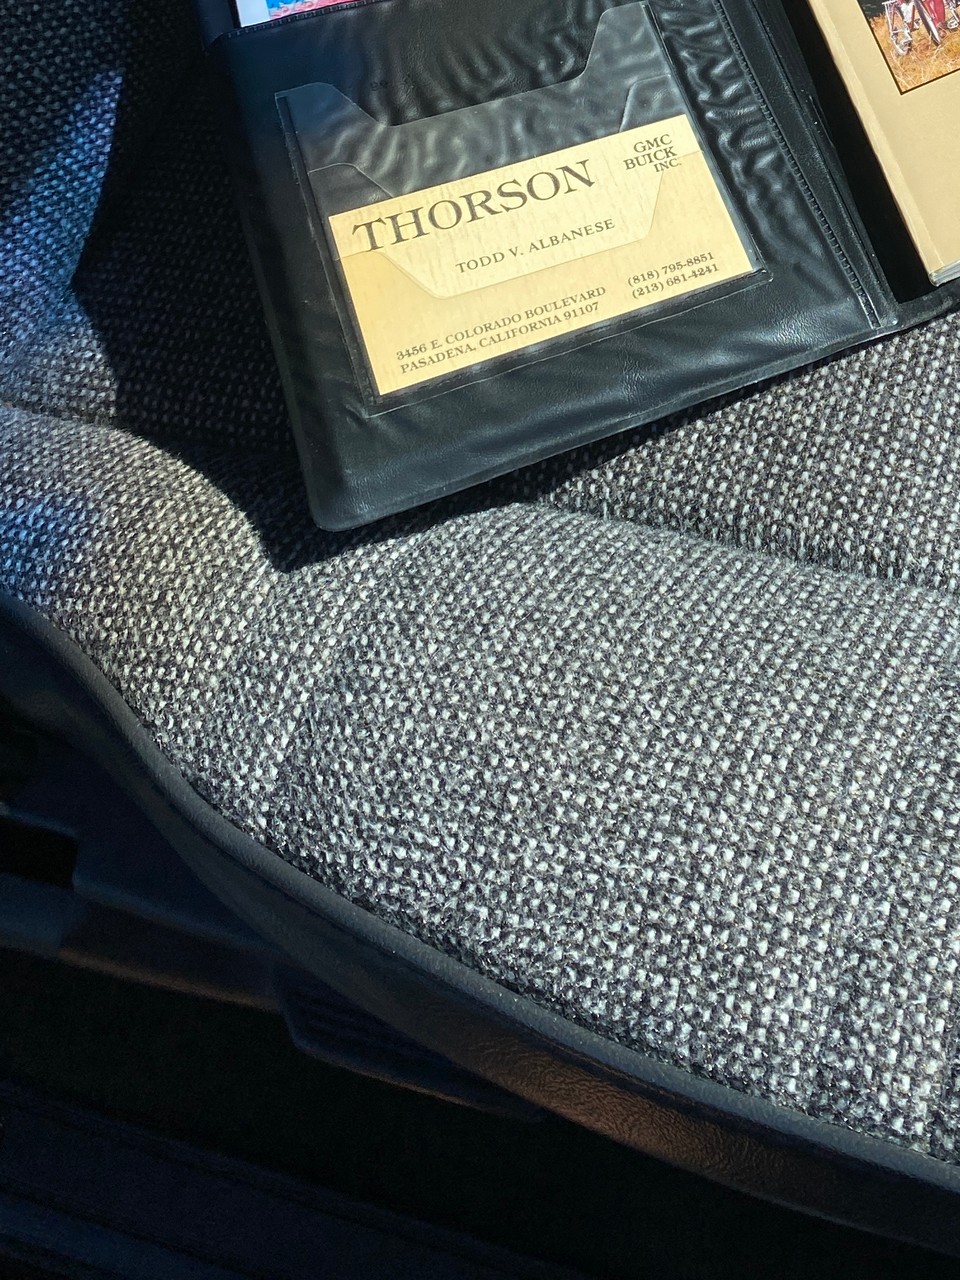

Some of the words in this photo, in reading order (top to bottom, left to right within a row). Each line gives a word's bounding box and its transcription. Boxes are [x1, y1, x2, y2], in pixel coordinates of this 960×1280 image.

[623, 146, 678, 170] BUICK
[633, 134, 673, 153] GMC
[653, 158, 682, 172] INC.
[352, 159, 596, 253] THORSON
[456, 251, 505, 274] TODD
[509, 245, 524, 258] V.
[528, 218, 615, 253] ALBANESE
[628, 269, 660, 287] (818)
[662, 252, 714, 275] 795-8851
[632, 281, 664, 299] (213)
[667, 263, 719, 287] 681-4241
[396, 343, 427, 361] 3456
[431, 339, 443, 350] E.
[445, 313, 522, 345] COLORADO
[524, 286, 606, 319] BOULEVARD
[400, 345, 477, 374] PASADENA,
[479, 315, 562, 348] CALIFORNIA
[563, 301, 600, 321] 91107
